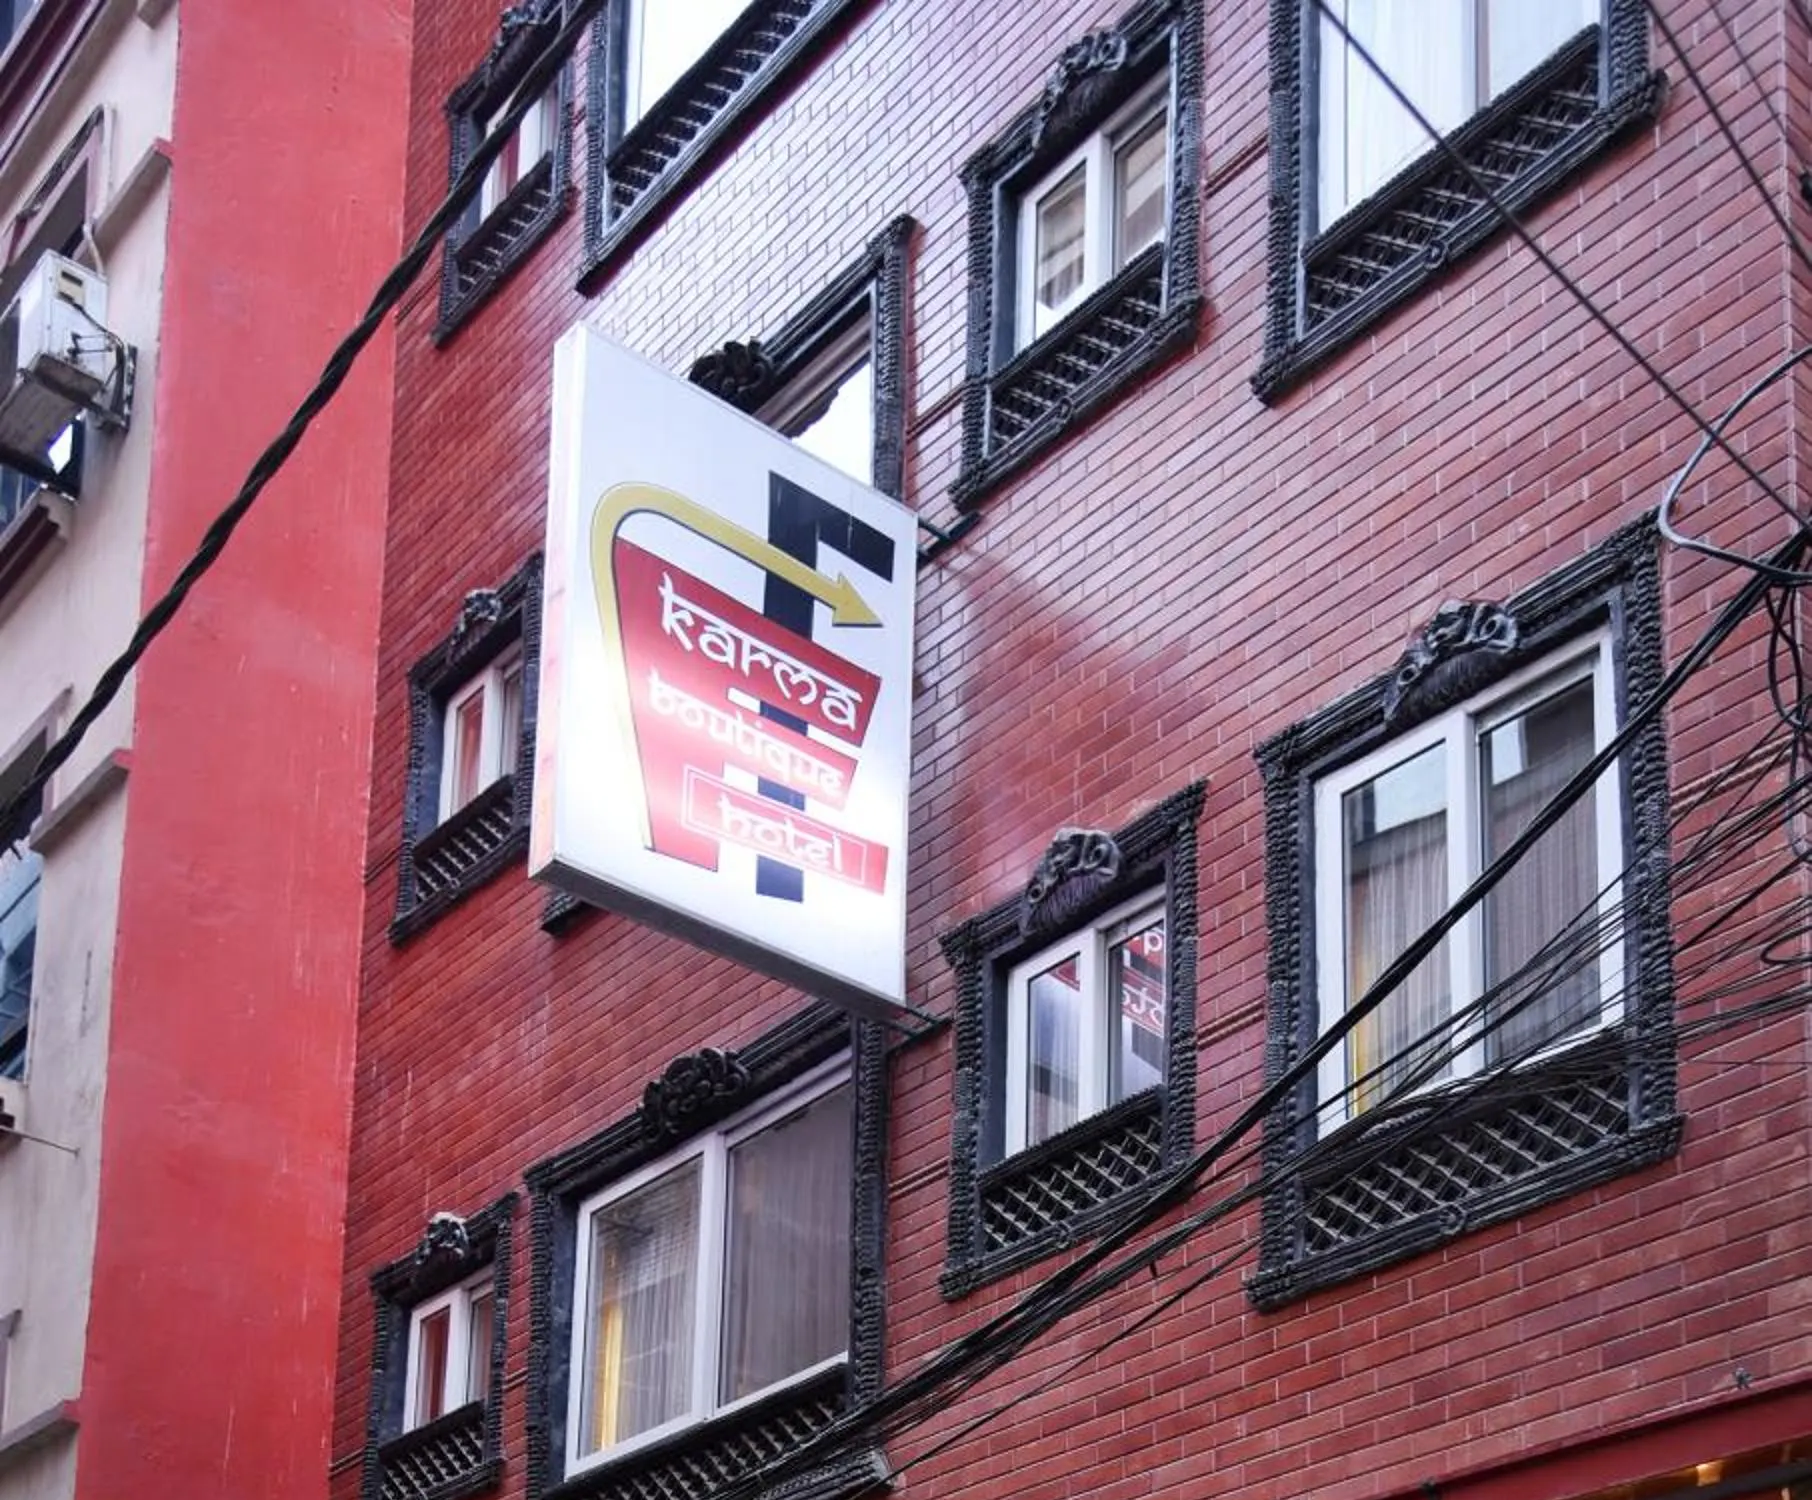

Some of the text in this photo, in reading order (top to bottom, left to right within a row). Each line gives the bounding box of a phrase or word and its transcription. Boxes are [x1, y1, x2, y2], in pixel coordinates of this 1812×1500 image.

[658, 571, 864, 732] karma
[648, 668, 844, 798] boutique
[717, 793, 843, 873] hotel
